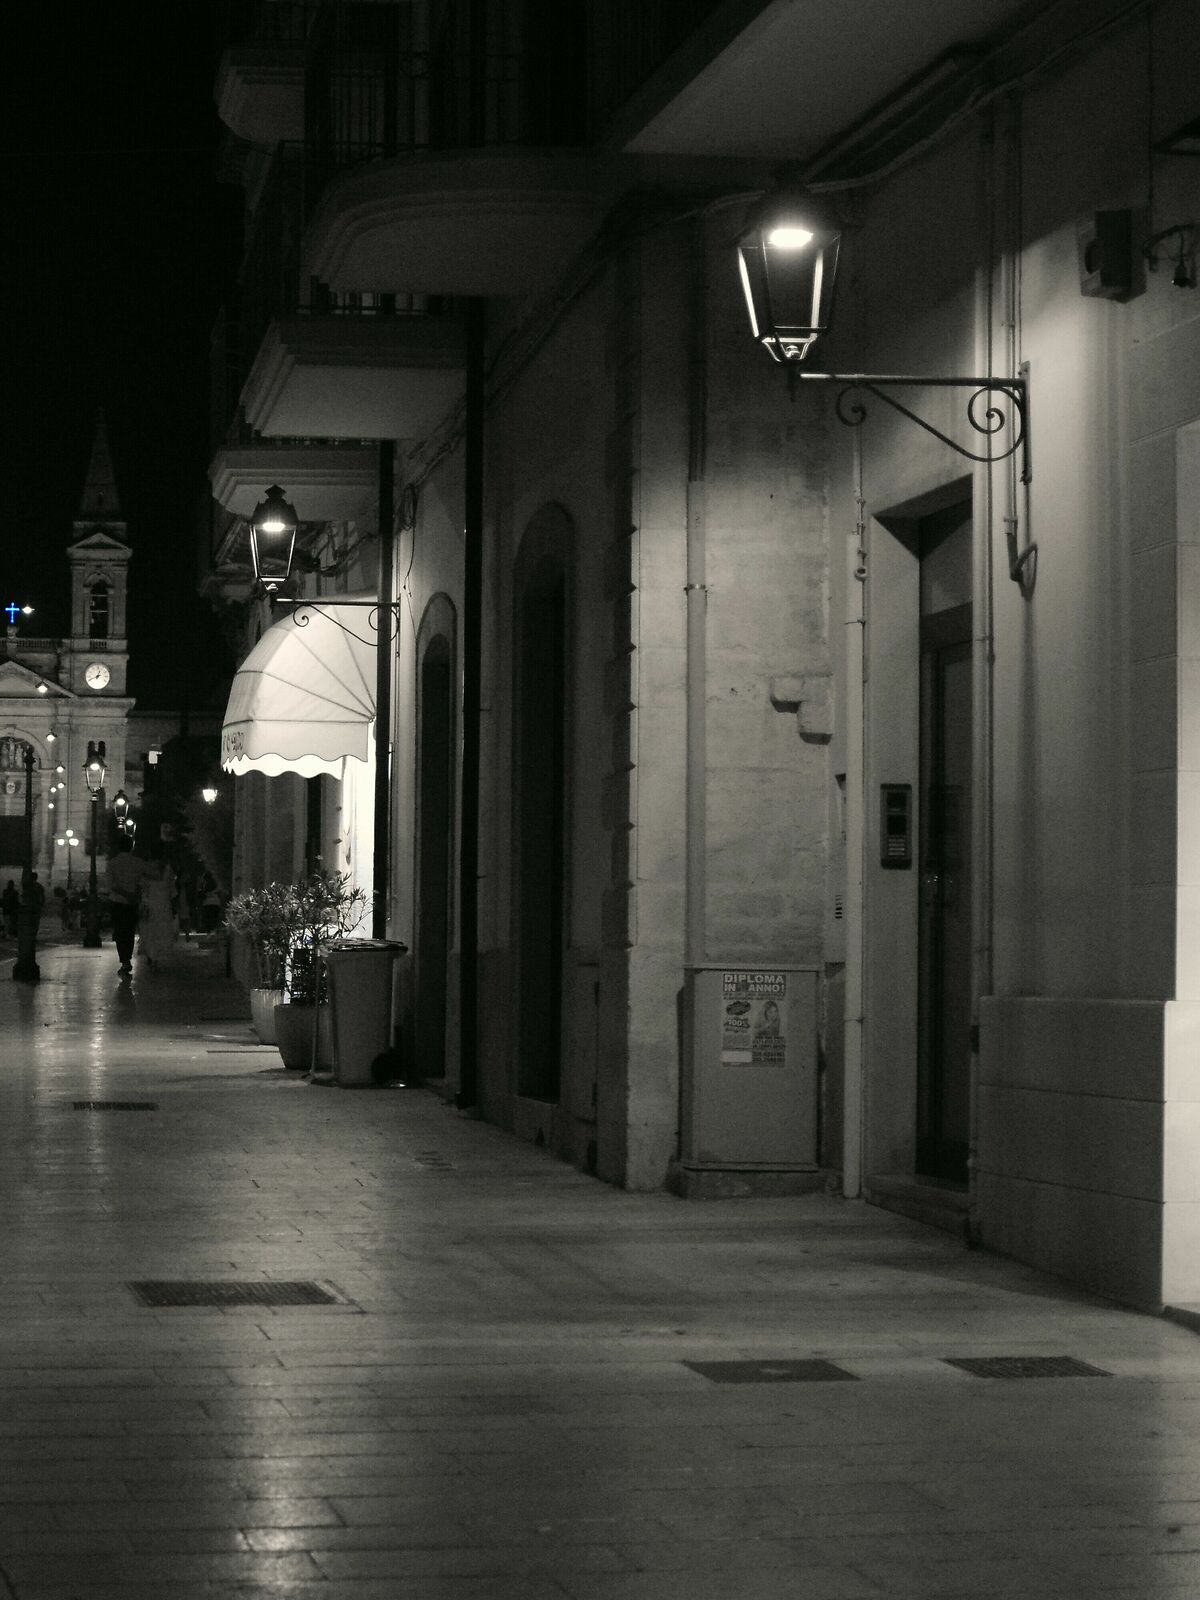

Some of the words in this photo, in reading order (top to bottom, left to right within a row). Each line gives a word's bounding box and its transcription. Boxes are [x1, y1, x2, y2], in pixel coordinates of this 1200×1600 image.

[724, 974, 784, 984] DIPLOMA
[724, 983, 737, 992] IN
[748, 983, 785, 993] ANNO!
